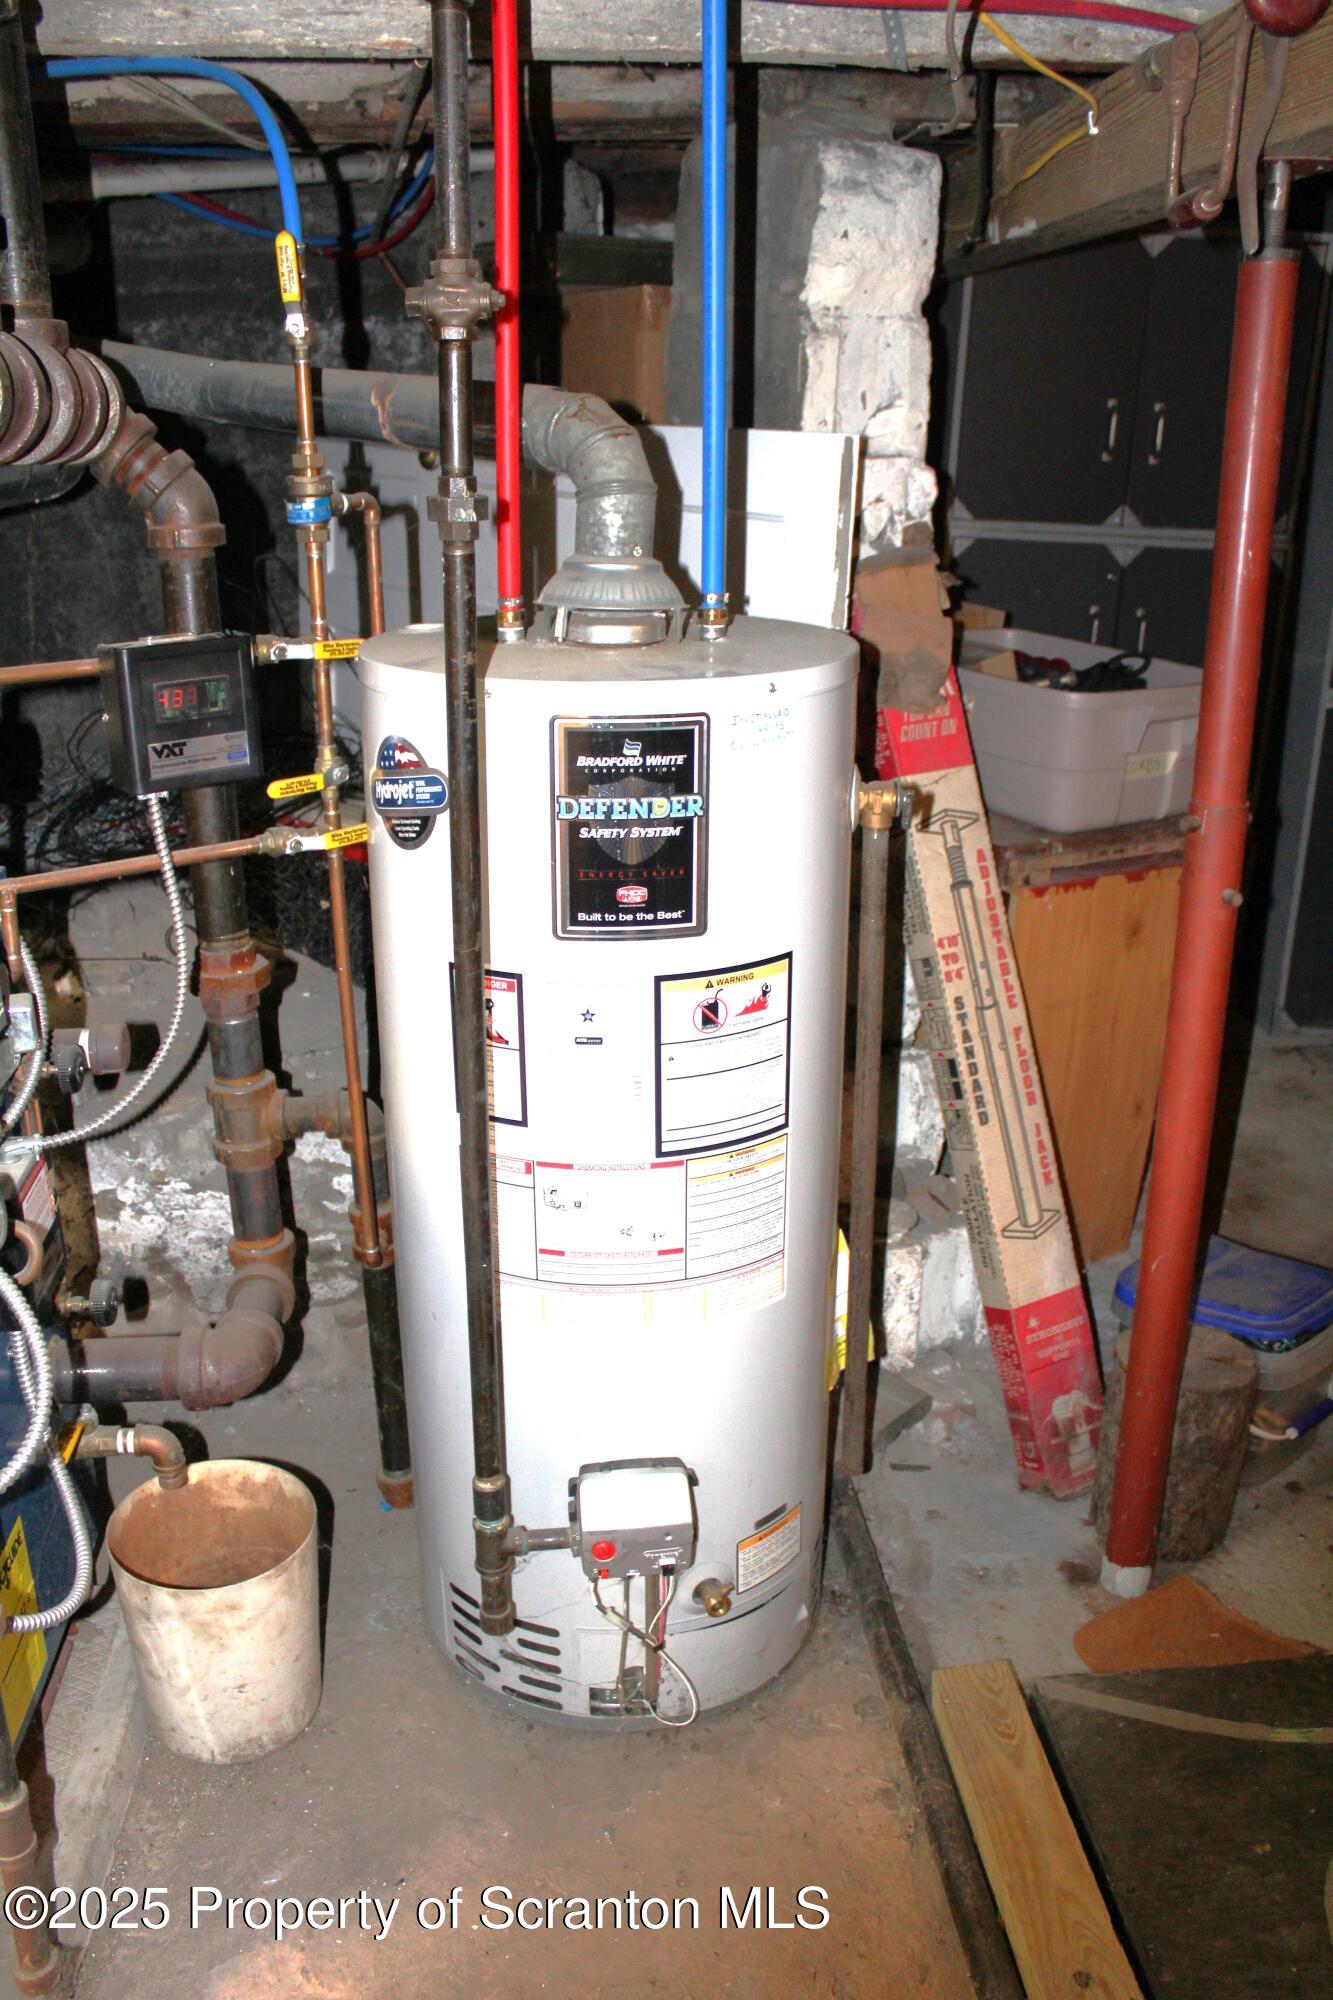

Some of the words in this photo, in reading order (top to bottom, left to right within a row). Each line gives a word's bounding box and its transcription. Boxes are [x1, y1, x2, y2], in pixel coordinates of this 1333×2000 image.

[900, 721, 937, 742] COUNT
[941, 718, 958, 736] ON
[577, 755, 643, 767] BRADFORD
[646, 754, 685, 766] WHITE
[376, 780, 414, 805] Hydrojet
[558, 795, 704, 820] DEFENDER
[579, 828, 629, 839] SAFETY
[630, 826, 682, 838] SYSTEM
[579, 870, 634, 878] ENERGY
[642, 867, 684, 878] SAVER
[578, 912, 602, 921] Built
[604, 913, 616, 921] to
[619, 912, 634, 920] be
[636, 912, 654, 920] the
[657, 910, 682, 920] Best
[976, 848, 1018, 1009] ADJUSTABLE
[942, 952, 959, 965] TO
[716, 972, 755, 987] WARNING
[954, 996, 989, 1126] STANDARD
[1013, 1026, 1037, 1106] FLOOR
[1035, 1122, 1053, 1186] JACK
